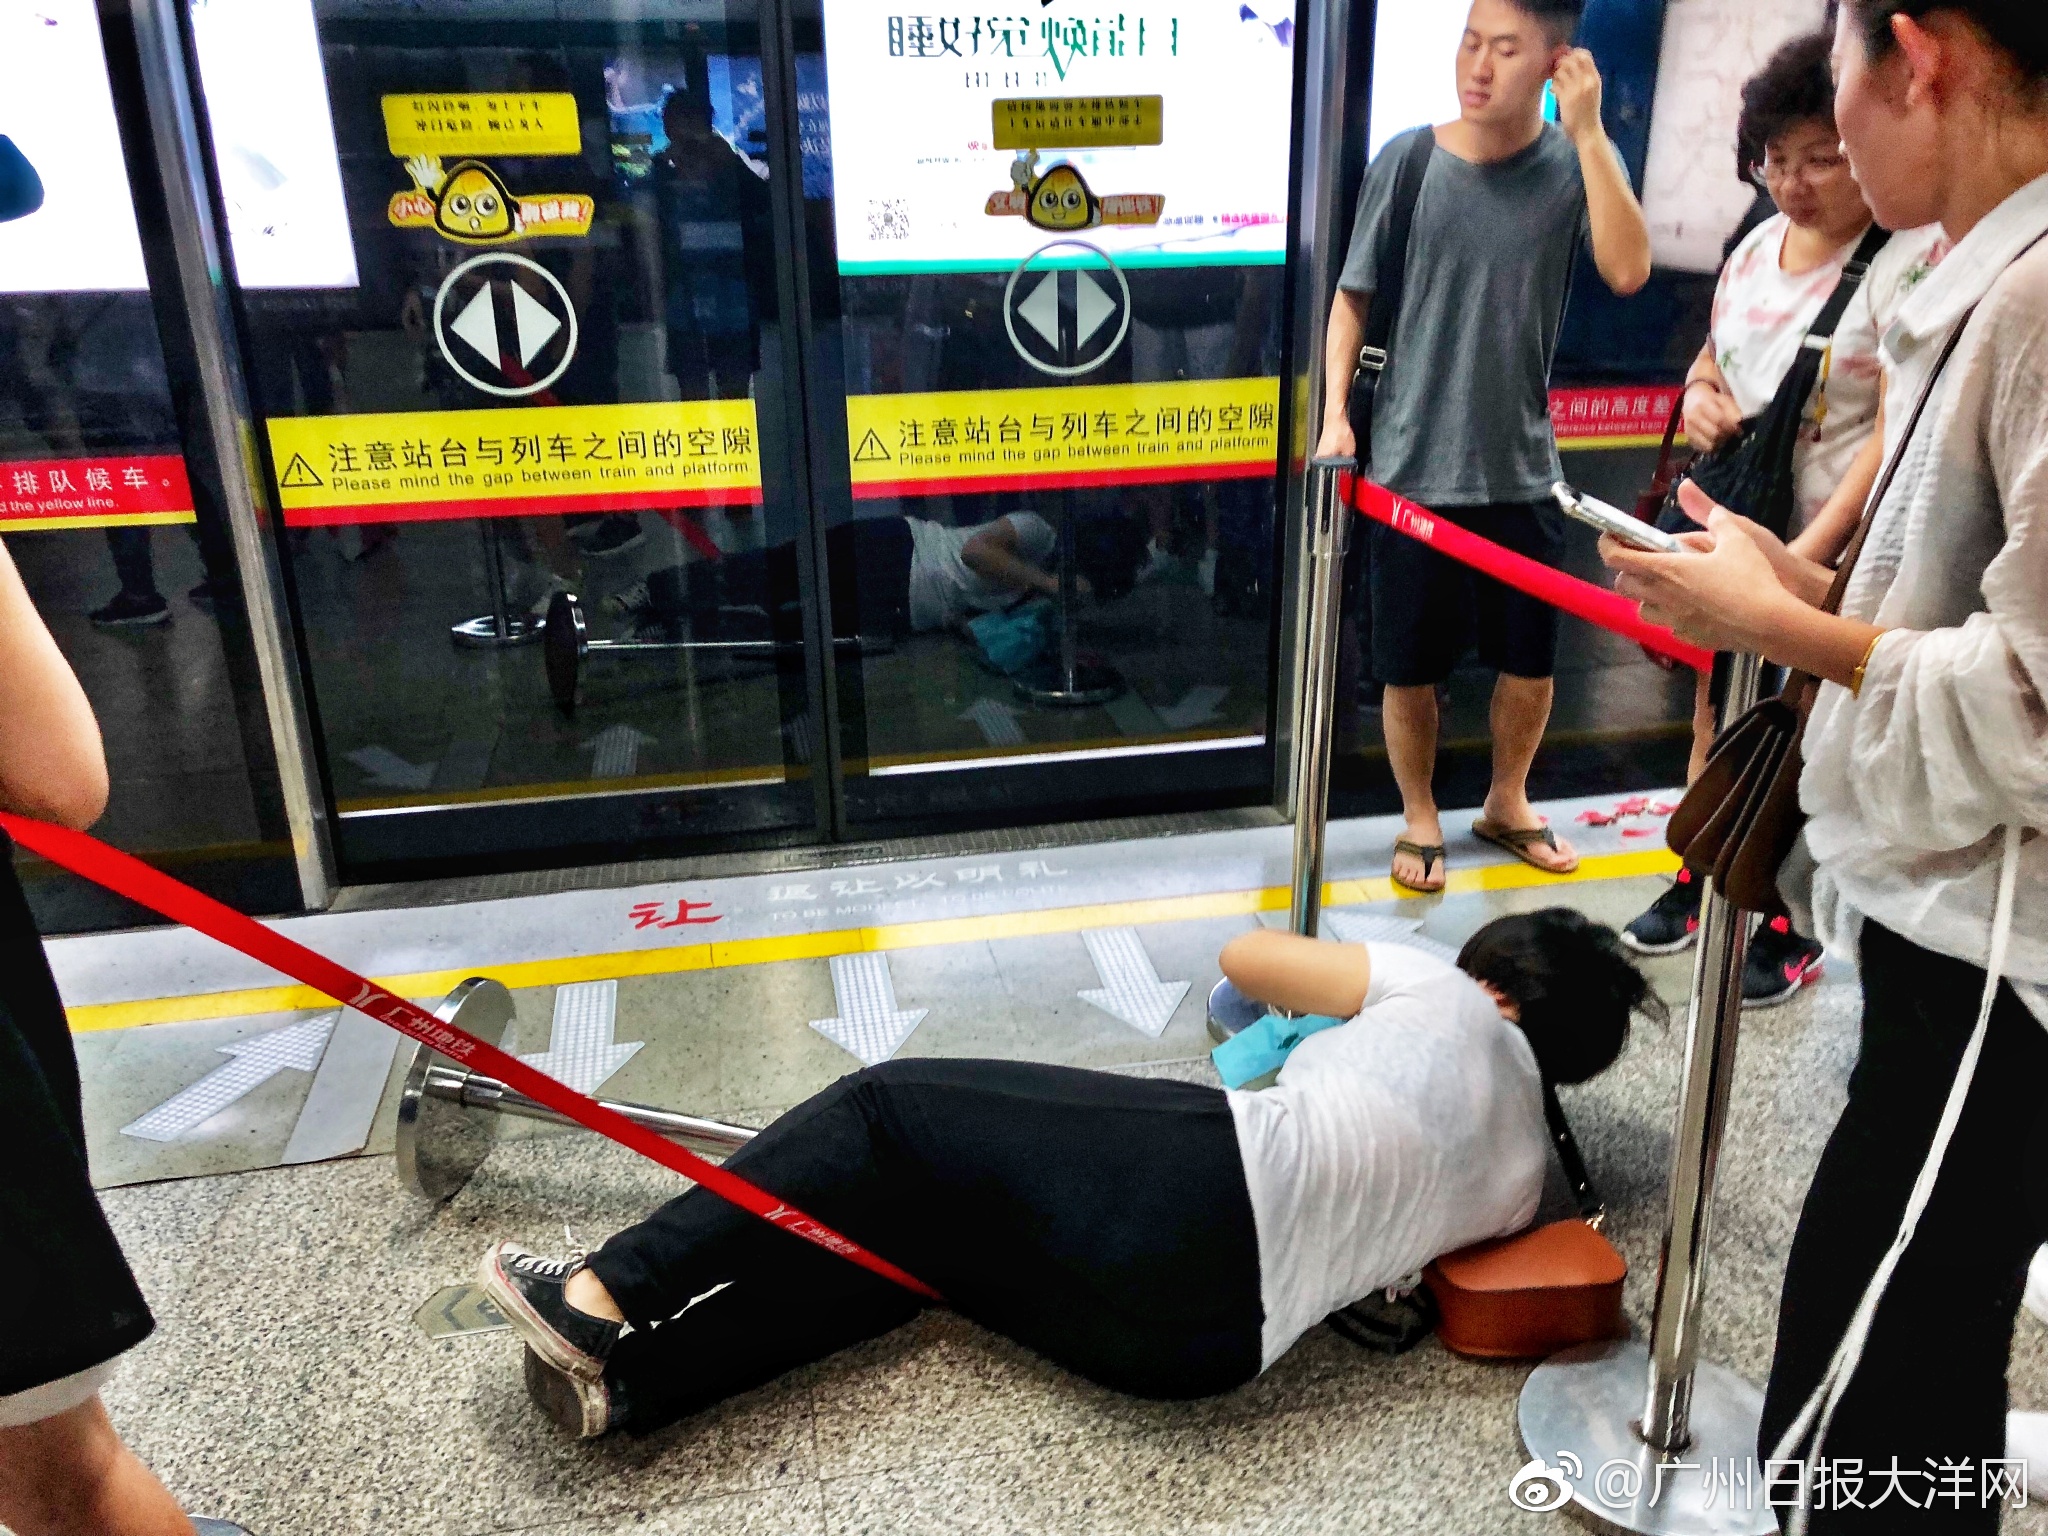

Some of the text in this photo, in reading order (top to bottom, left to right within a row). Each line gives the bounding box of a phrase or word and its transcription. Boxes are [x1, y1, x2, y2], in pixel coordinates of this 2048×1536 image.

[899, 402, 1274, 448] 注意站台与列车之间的空隙
[328, 426, 753, 473] 注意站台与列车之间的空隙
[899, 451, 951, 466] Please
[959, 448, 995, 464] mind
[1002, 447, 1026, 461] the
[1033, 446, 1061, 462] gap
[1067, 443, 1130, 458] between
[1137, 440, 1169, 455] train
[1177, 437, 1203, 452] and
[0, 466, 170, 495] 排队候车。
[332, 476, 391, 492] Please
[400, 473, 440, 489] mind
[449, 472, 475, 486] the
[482, 471, 514, 487] gap
[522, 467, 592, 483] between
[599, 464, 637, 478] train
[645, 462, 675, 477] and
[10, 500, 35, 513] the
[38, 498, 84, 514] yellow
[628, 899, 724, 931] 让
[380, 1006, 476, 1057] 广州地铁
